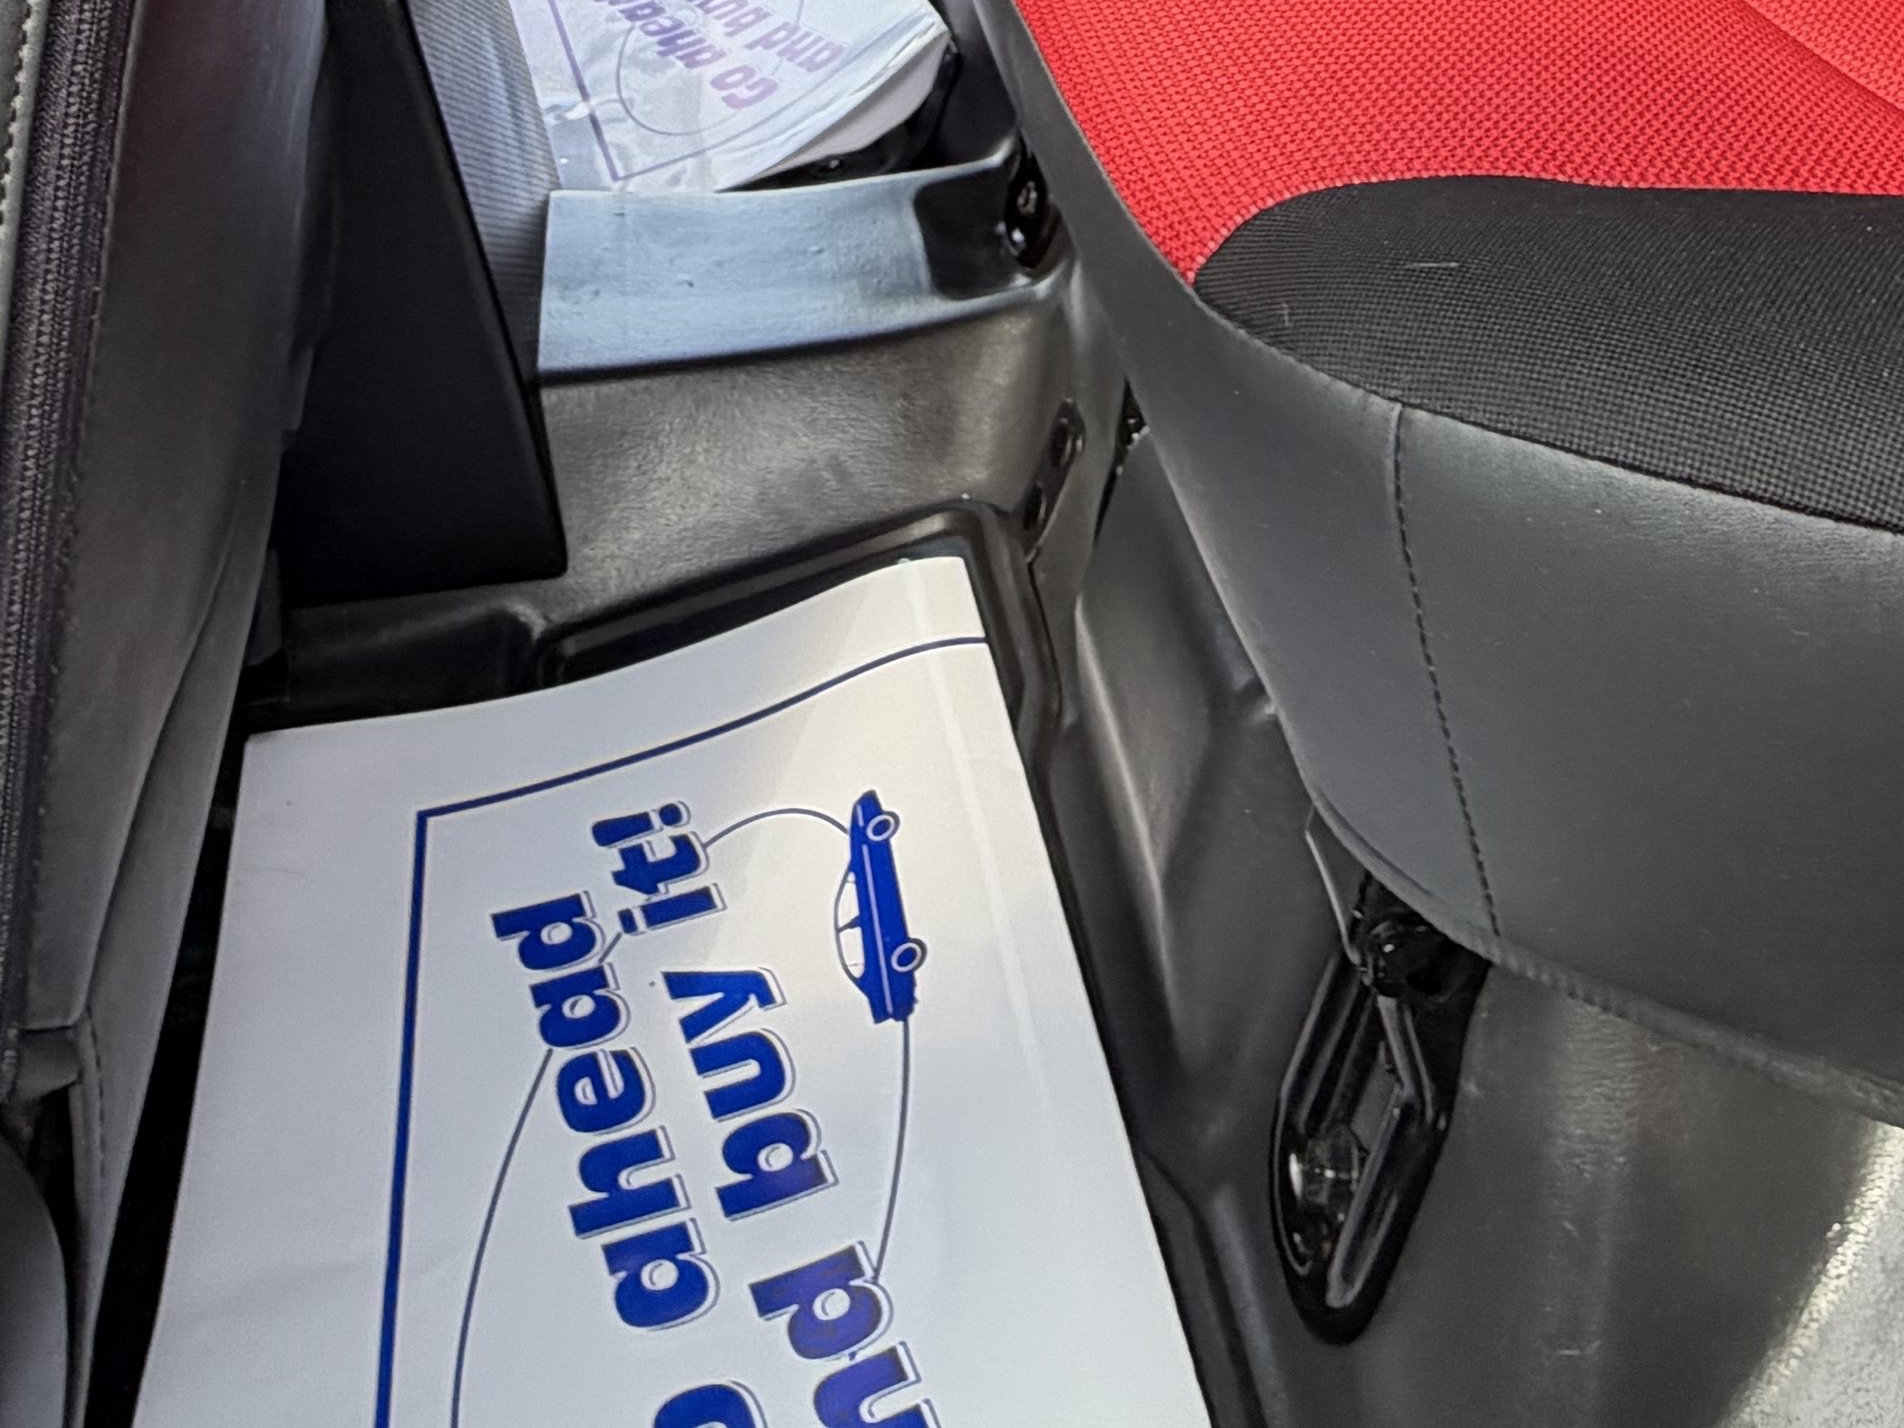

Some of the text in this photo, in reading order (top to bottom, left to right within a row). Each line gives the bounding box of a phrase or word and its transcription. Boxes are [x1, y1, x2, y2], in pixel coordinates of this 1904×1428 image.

[709, 63, 779, 109] Go
[745, 20, 847, 74] and
[590, 800, 729, 936] it!
[490, 889, 721, 1332] ahead
[660, 967, 841, 1222] buy
[747, 1241, 941, 1428] nd
